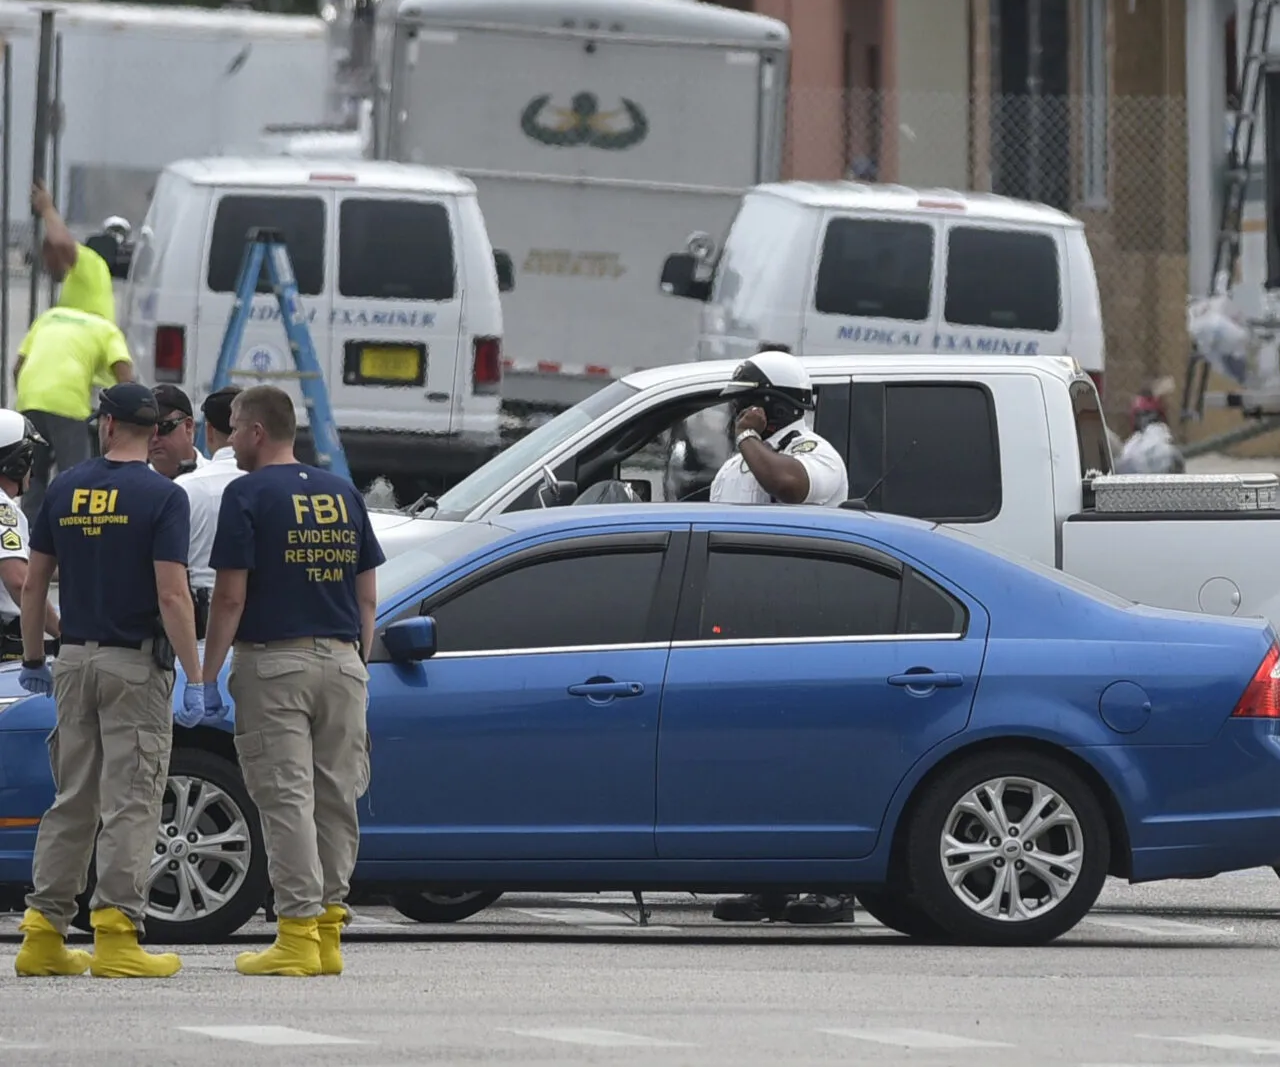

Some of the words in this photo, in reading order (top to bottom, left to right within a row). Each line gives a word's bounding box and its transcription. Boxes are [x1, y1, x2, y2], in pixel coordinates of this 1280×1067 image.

[932, 333, 1040, 355] EXAMINER
[72, 488, 119, 514] FBI
[291, 494, 349, 524] FBI
[59, 516, 92, 527] EVIDENCE
[82, 527, 102, 536] TEAM
[287, 529, 357, 545] EVIDENCE
[284, 548, 358, 564] RESPONSE
[305, 568, 344, 583] TEAM
